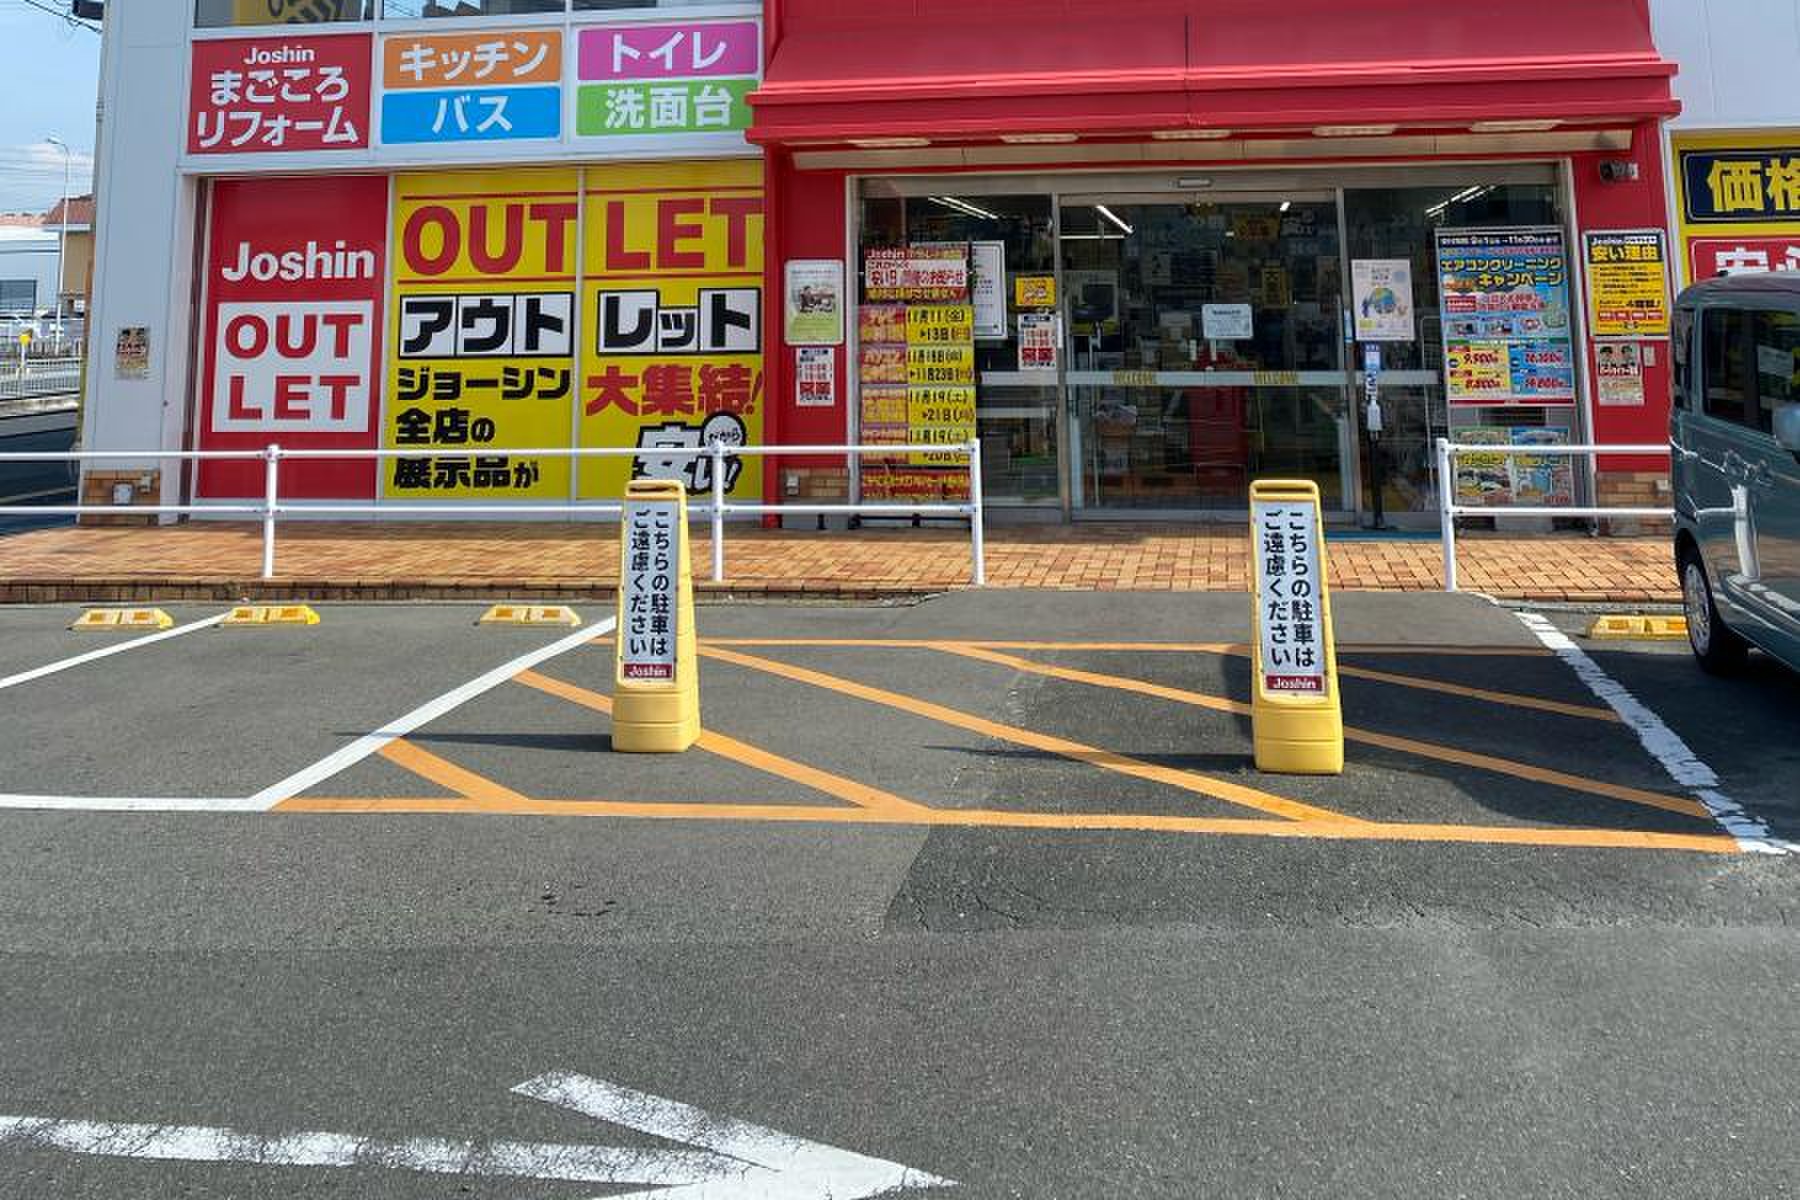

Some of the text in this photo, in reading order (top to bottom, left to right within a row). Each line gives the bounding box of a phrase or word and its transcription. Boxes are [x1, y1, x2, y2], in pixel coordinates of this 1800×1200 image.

[243, 45, 315, 65] Joshin
[399, 39, 549, 82] キッチン
[610, 32, 728, 72] トイレ
[210, 66, 350, 105] まごころ
[196, 106, 359, 147] リフォーム
[431, 95, 514, 134] バス
[605, 86, 735, 130] 洗面台
[222, 240, 375, 282] Joshin
[1440, 257, 1562, 271] エアコンクリーニング
[1591, 245, 1659, 262] 安い理由
[1478, 271, 1563, 287] キャンペーン
[225, 314, 363, 360] OUT
[228, 375, 360, 420] LET
[397, 367, 572, 402] ジョーシン
[395, 408, 496, 445] 全店の
[394, 459, 540, 490] 展示品が
[630, 508, 651, 656] ご遠慮ください
[650, 511, 671, 657] こちらの駐車は
[1263, 509, 1291, 667] ご遠慮ください
[1288, 511, 1316, 668] こちらの駐車は
[627, 664, 668, 678] Joshin
[1272, 676, 1317, 690] Joshin
